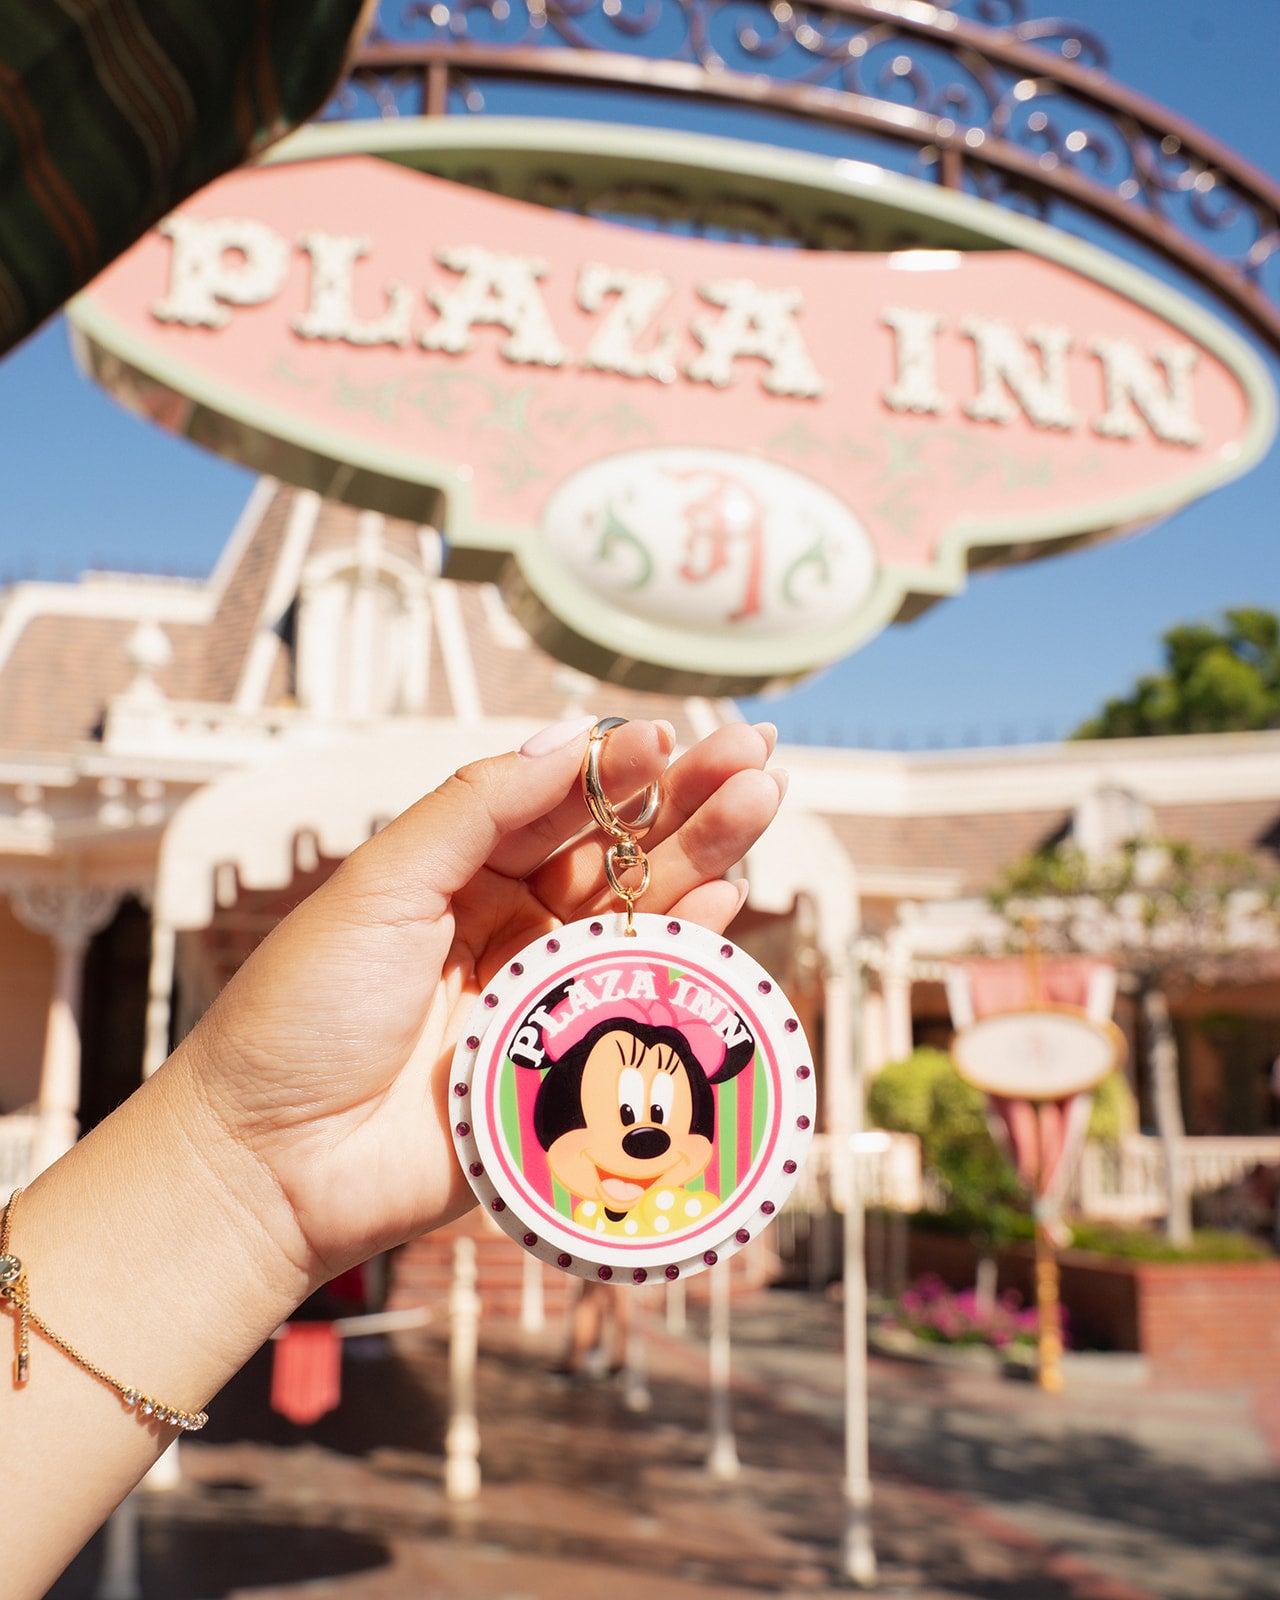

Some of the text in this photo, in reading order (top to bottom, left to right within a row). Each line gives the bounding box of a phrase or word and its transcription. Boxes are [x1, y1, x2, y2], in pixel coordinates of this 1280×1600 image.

[151, 214, 1201, 446] PLAZA INN
[509, 969, 753, 1068] PLAZA INN
